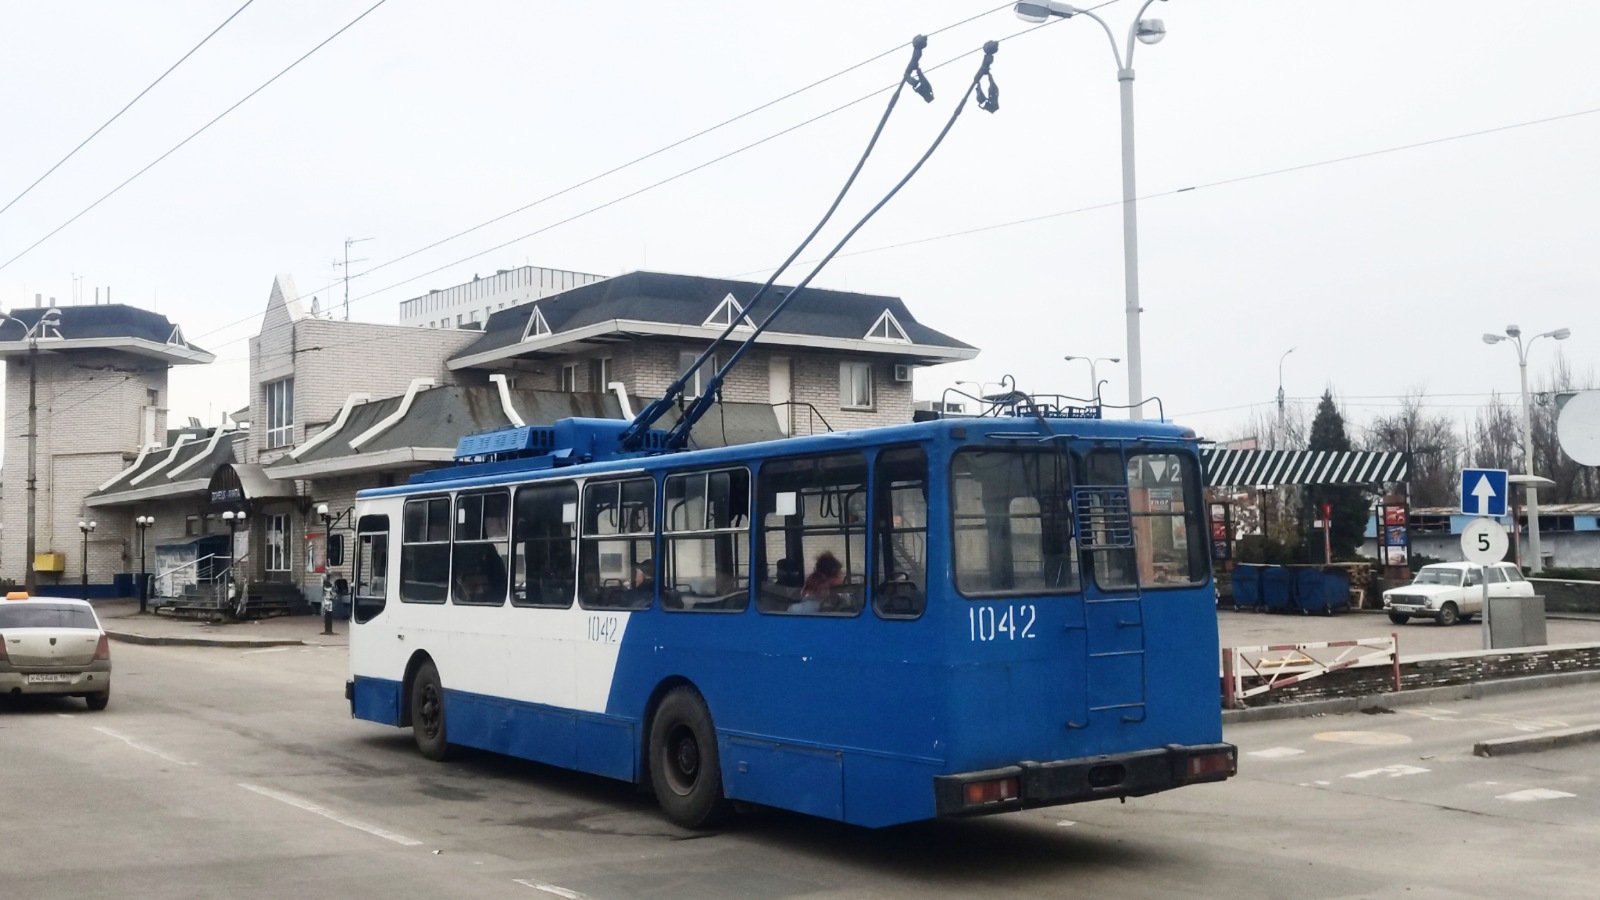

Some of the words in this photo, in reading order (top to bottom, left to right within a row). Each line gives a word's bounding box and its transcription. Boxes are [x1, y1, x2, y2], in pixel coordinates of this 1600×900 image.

[1478, 533, 1490, 552] 5
[588, 616, 617, 643] 1042
[969, 604, 1036, 642] 1042
